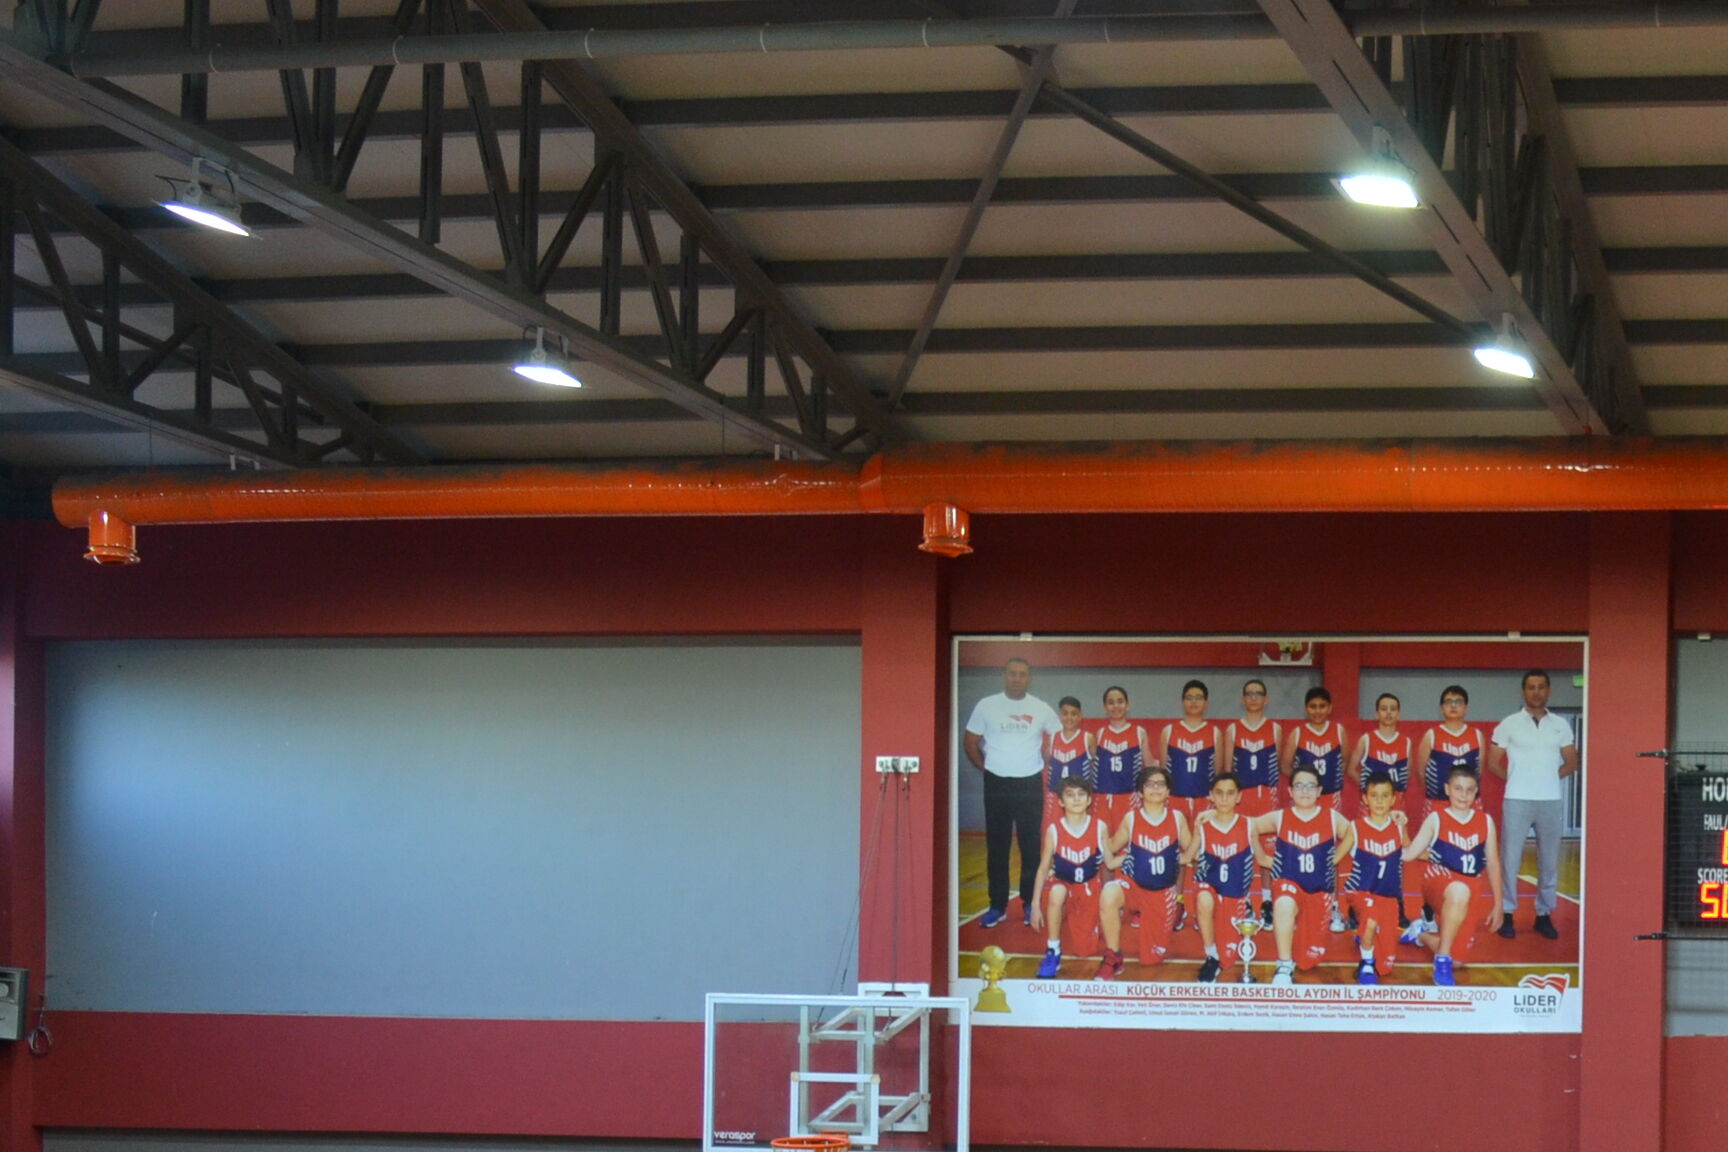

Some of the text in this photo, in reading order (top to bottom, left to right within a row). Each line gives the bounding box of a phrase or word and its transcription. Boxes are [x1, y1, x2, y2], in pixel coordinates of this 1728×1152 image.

[1110, 757, 1123, 772] 15
[1185, 756, 1198, 773] 17
[1249, 755, 1257, 771] 9
[1148, 856, 1165, 876] 10
[1219, 863, 1229, 882] 6
[1298, 853, 1314, 874] 18
[1378, 861, 1386, 879] 7
[1460, 854, 1476, 874] 12
[1074, 867, 1084, 883] 8
[1028, 983, 1497, 1002] OKULLAR ARASI KÜÇÜK ERKEKLER BASKETBOL AYDIN İL ŞAMPİYONU 2019-2020
[1513, 993, 1557, 1007] LİDER
